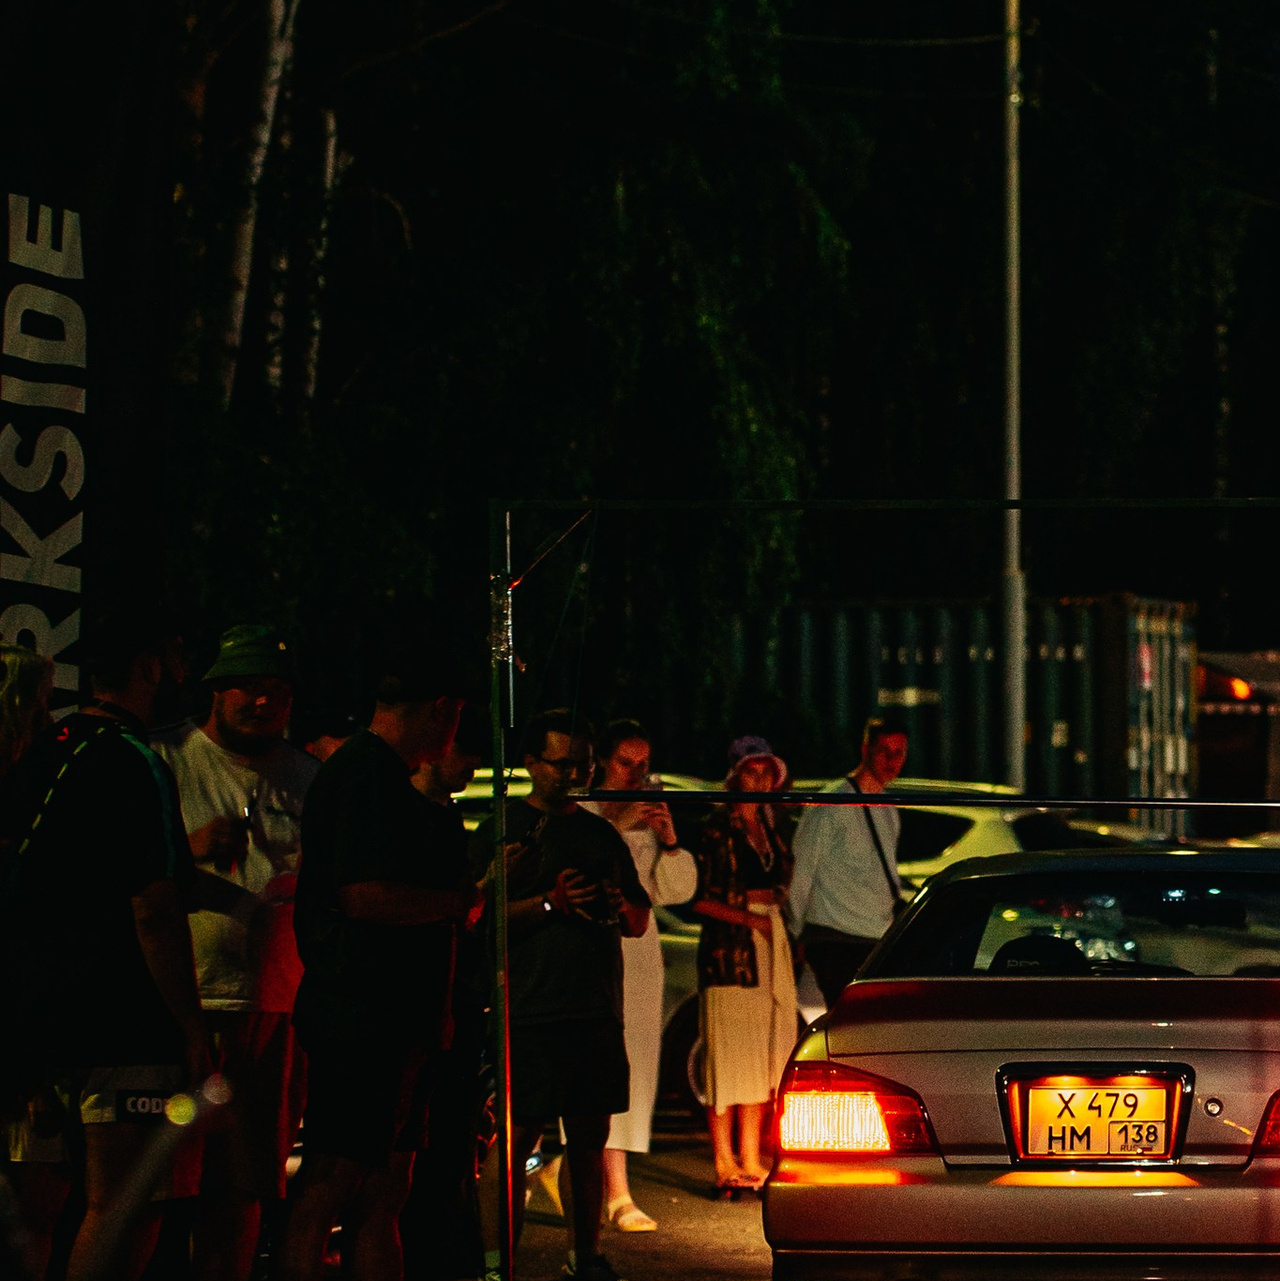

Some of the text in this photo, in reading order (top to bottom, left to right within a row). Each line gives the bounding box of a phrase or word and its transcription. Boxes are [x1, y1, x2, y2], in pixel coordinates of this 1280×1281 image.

[125, 1096, 168, 1114] COD
[1057, 1093, 1138, 1118] Х 479
[1048, 1124, 1158, 1151] НМ 138
